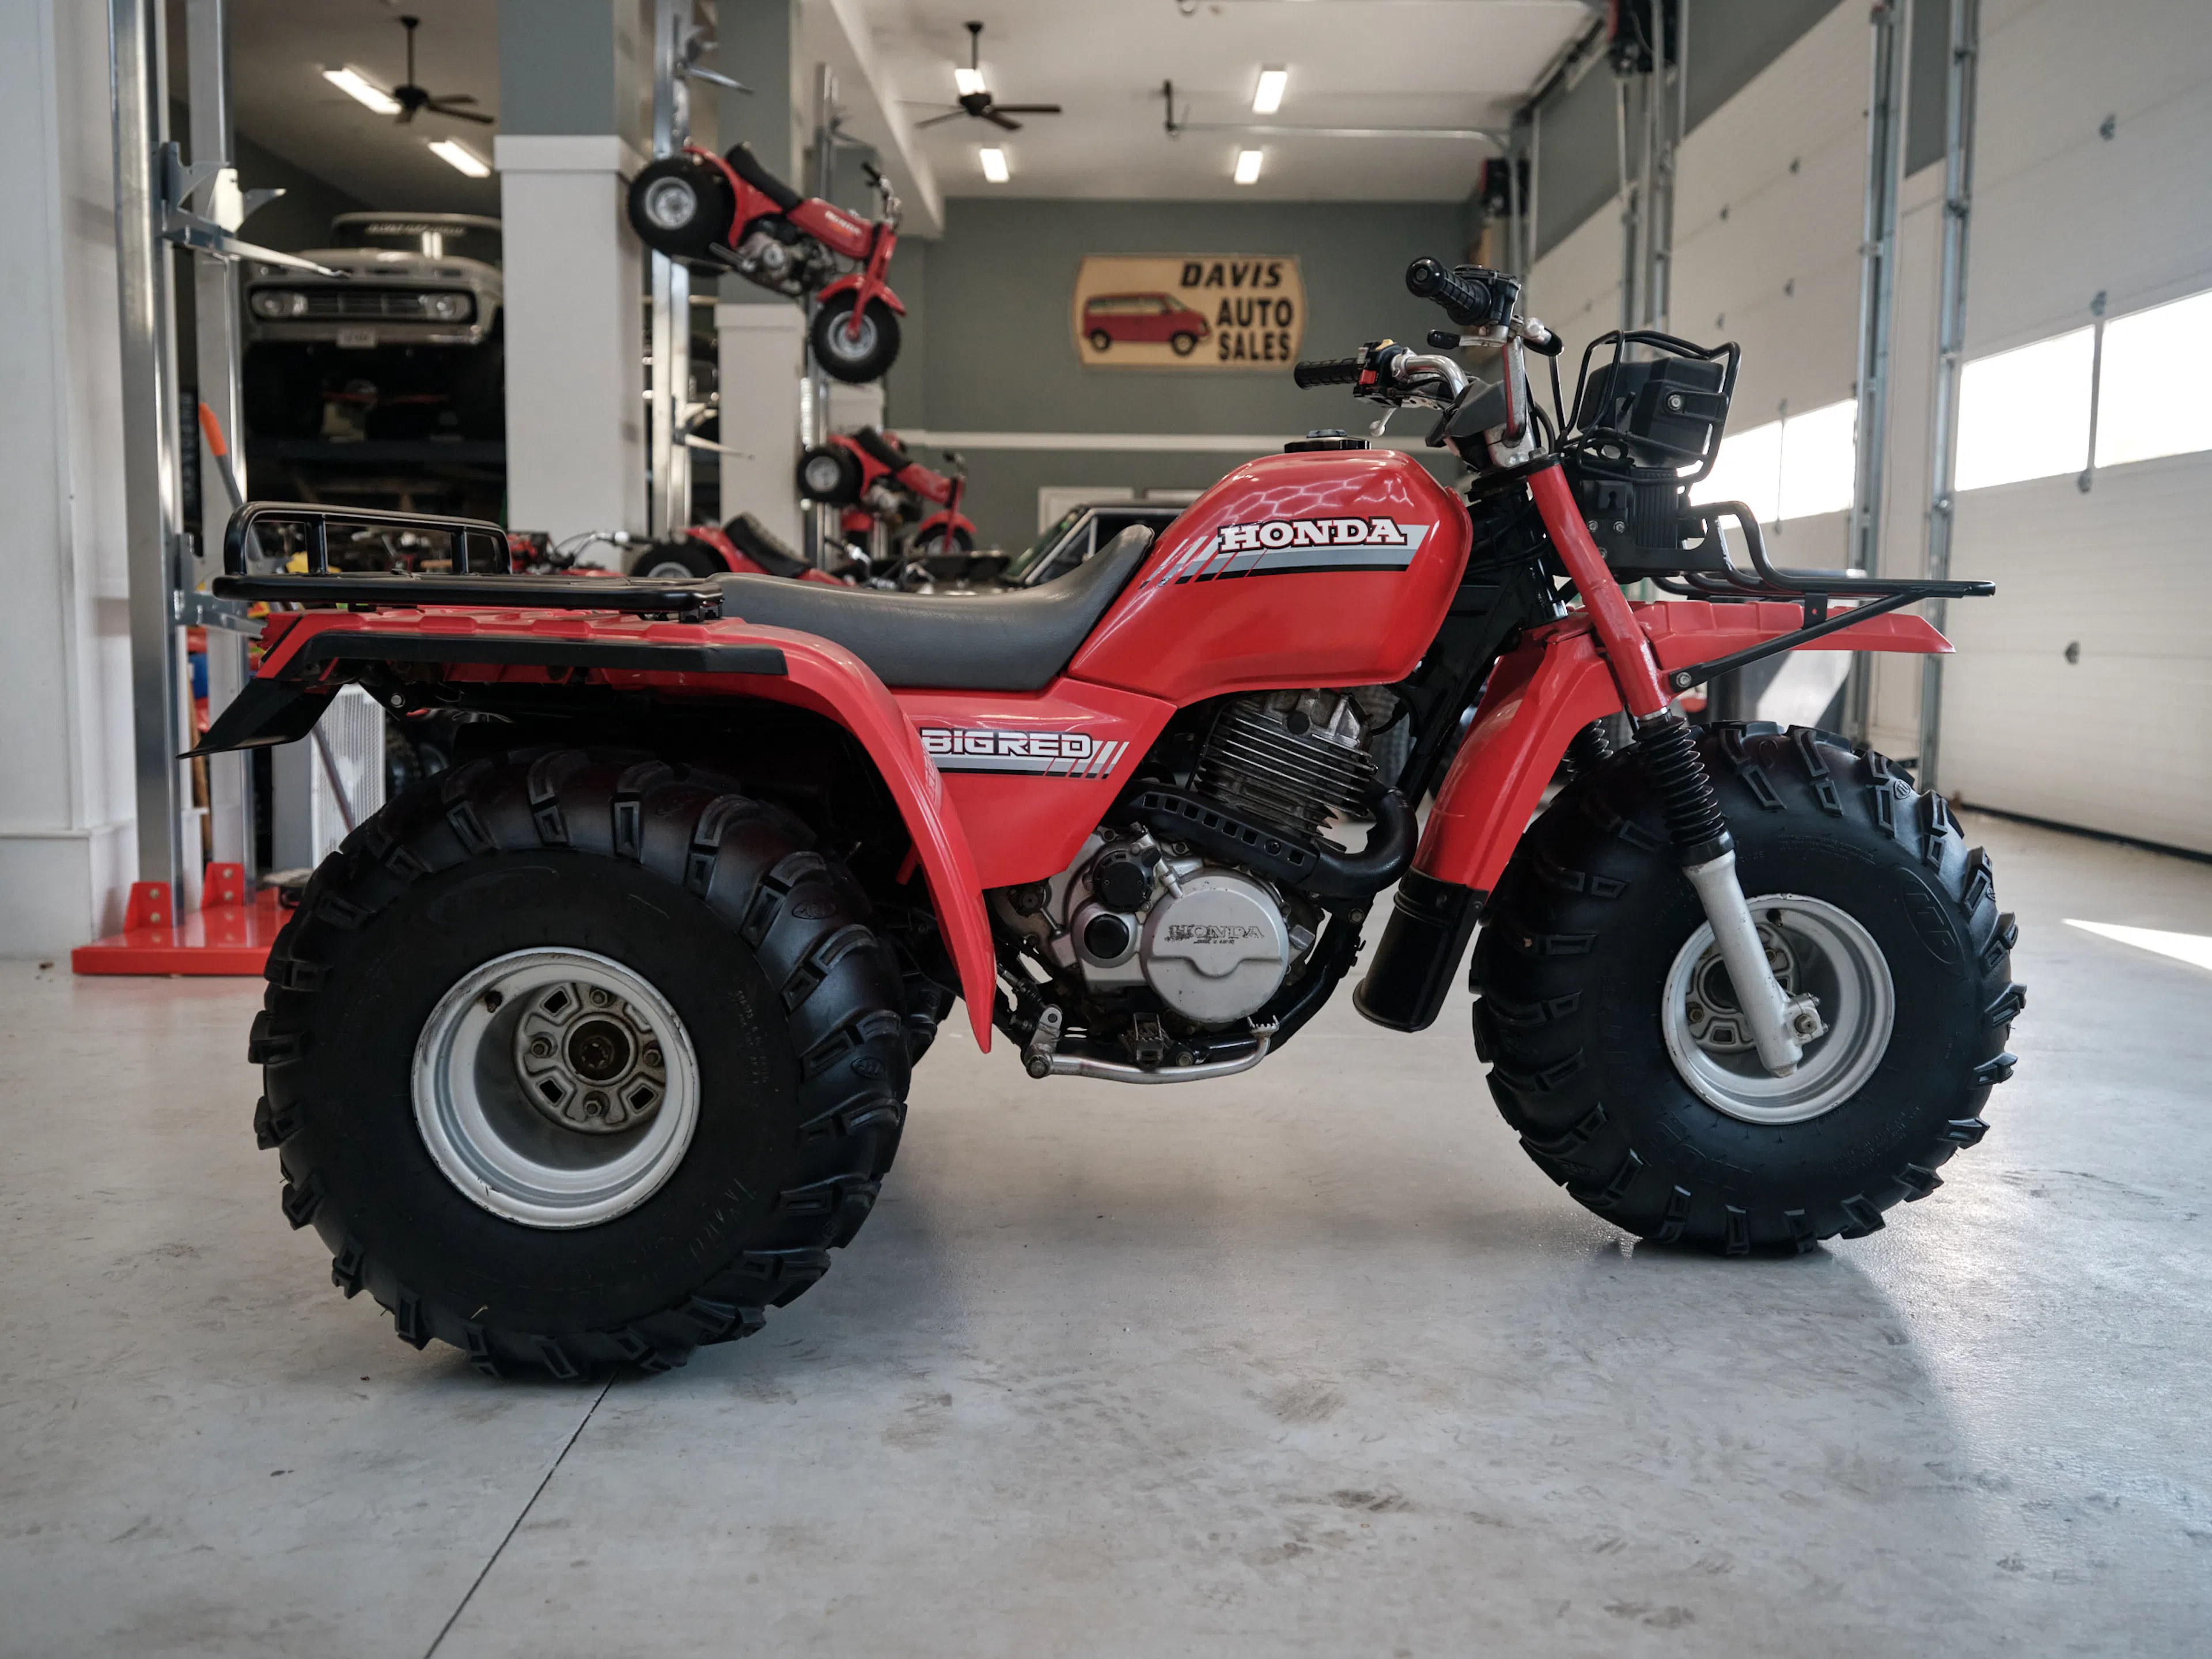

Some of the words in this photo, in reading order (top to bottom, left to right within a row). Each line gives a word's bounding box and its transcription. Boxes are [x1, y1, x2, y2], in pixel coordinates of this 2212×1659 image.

[1181, 262, 1282, 287] DAVIS
[1217, 297, 1293, 327] AUTO
[1219, 331, 1290, 361] SALES
[1218, 517, 1407, 553] HONDA
[1169, 925, 1265, 939] HONDA
